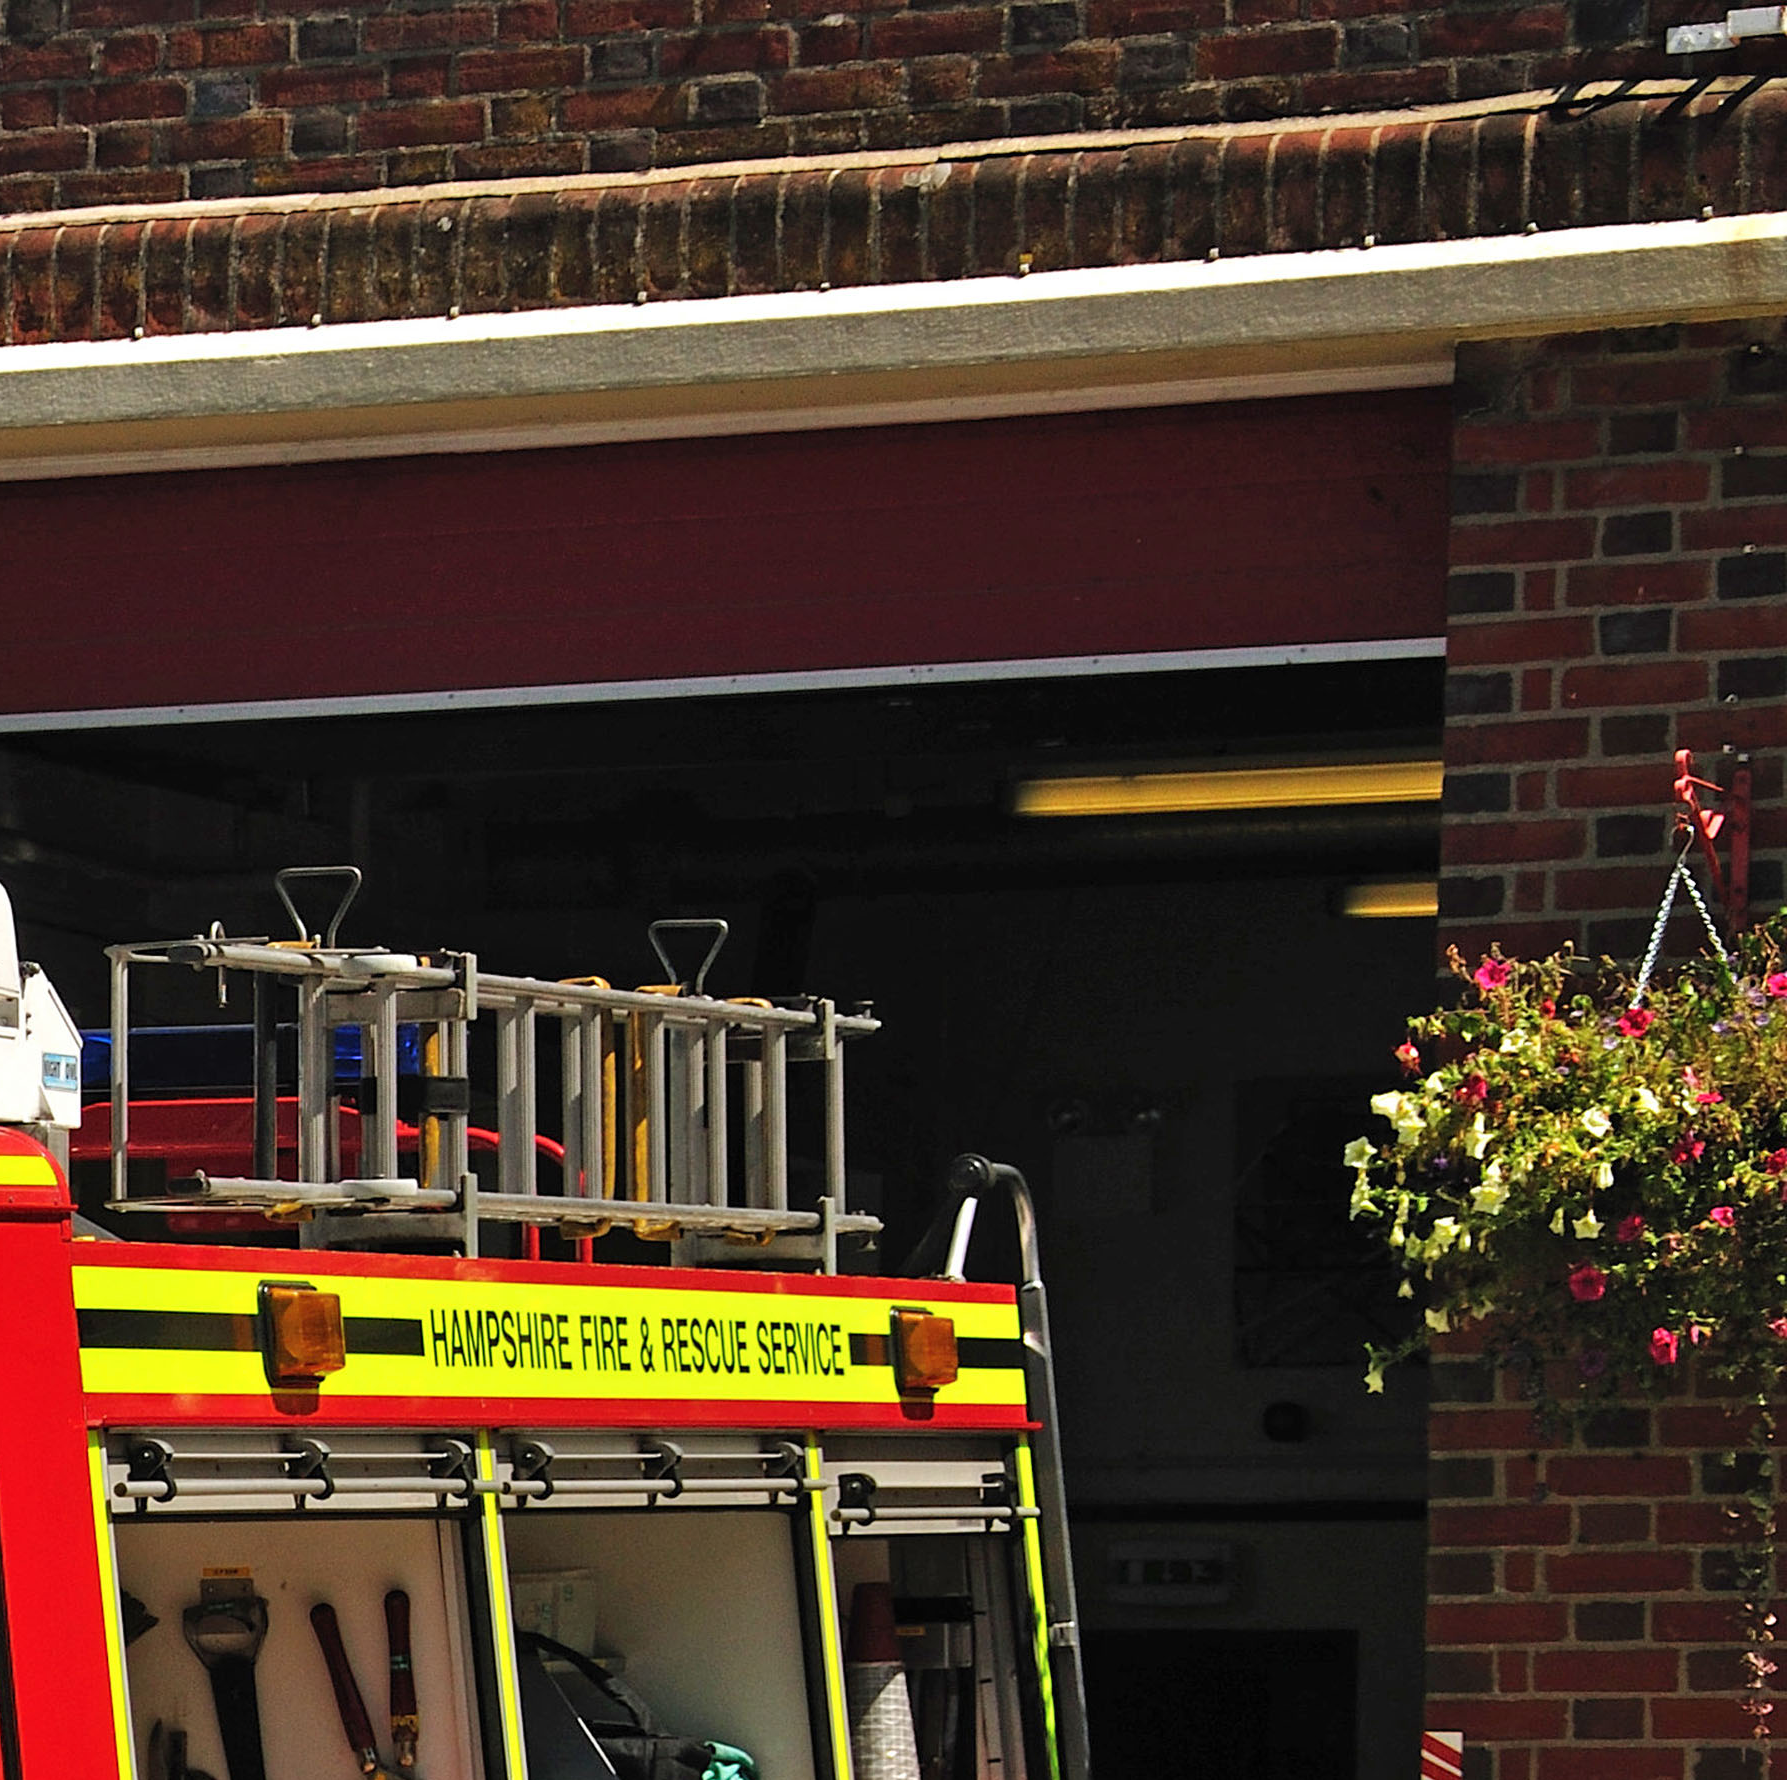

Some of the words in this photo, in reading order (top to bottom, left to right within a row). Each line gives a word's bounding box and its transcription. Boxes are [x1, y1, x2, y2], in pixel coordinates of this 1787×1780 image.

[429, 1308, 573, 1370] HAMPSHIRE
[580, 1315, 632, 1372] FIRE
[639, 1316, 656, 1373] &
[661, 1318, 751, 1374] RESCUE
[756, 1320, 845, 1376] SERVICE
